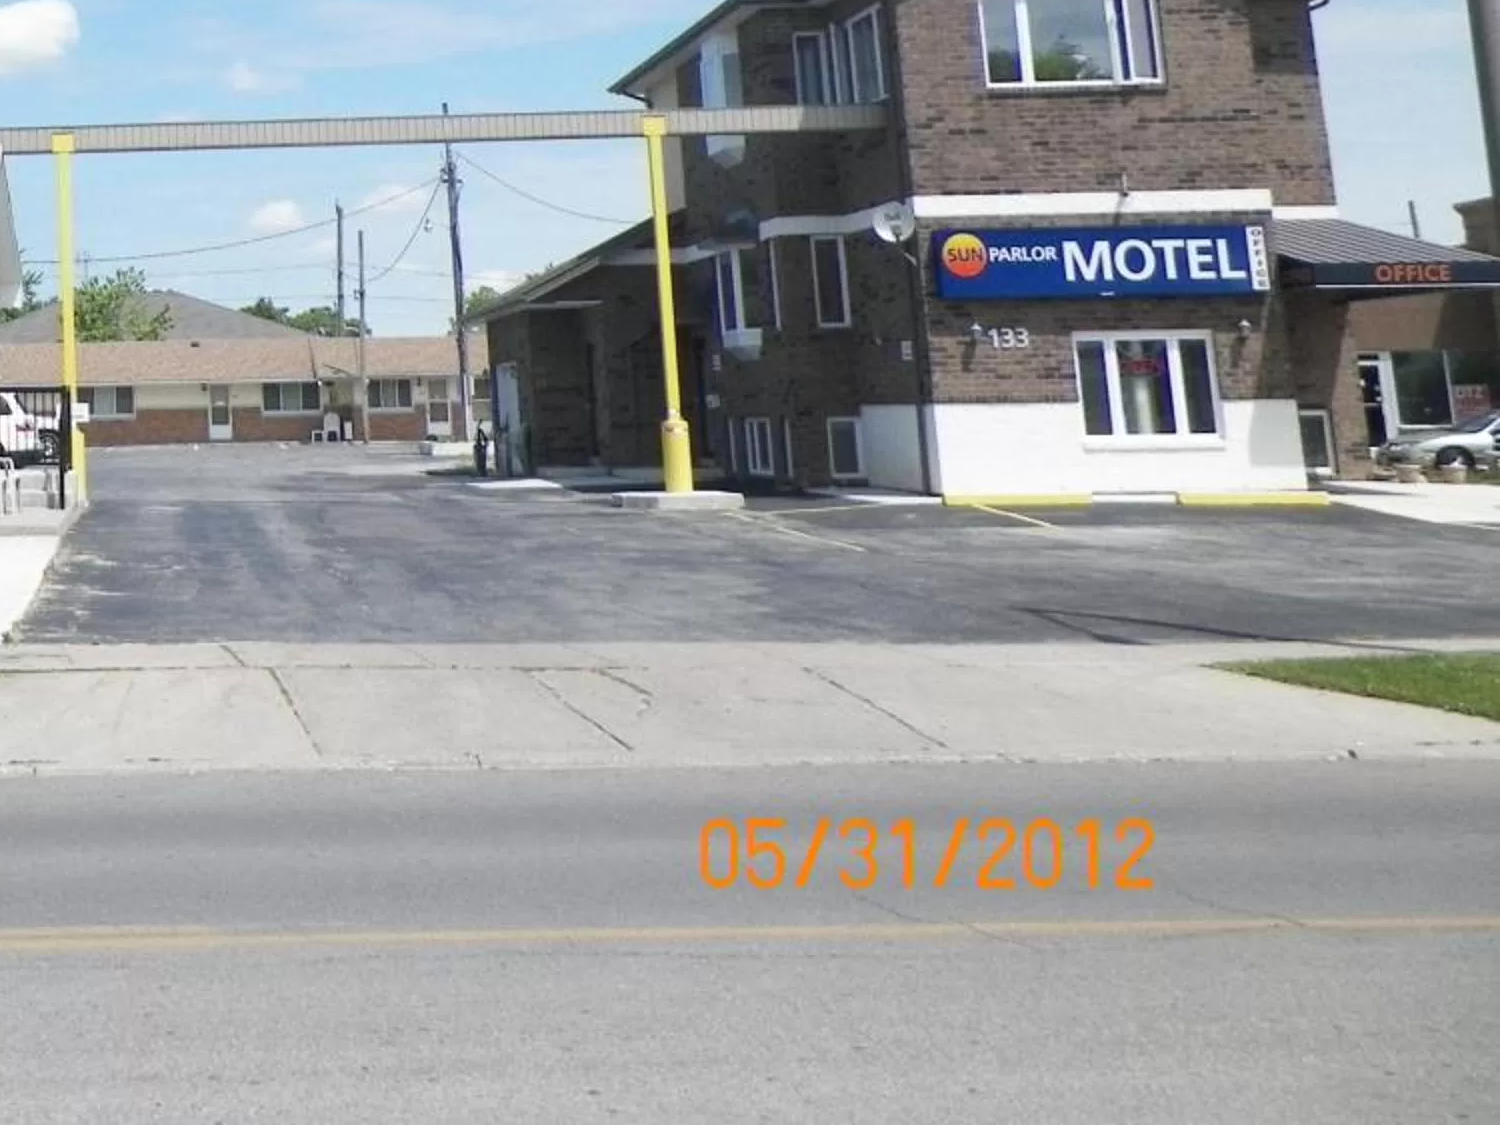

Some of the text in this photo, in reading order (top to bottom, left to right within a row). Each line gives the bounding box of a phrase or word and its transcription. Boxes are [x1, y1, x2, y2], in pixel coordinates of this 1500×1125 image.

[947, 238, 1247, 282] SUN PARLOR MOTEL
[1376, 264, 1452, 282] OFFICE
[987, 327, 1029, 348] 133
